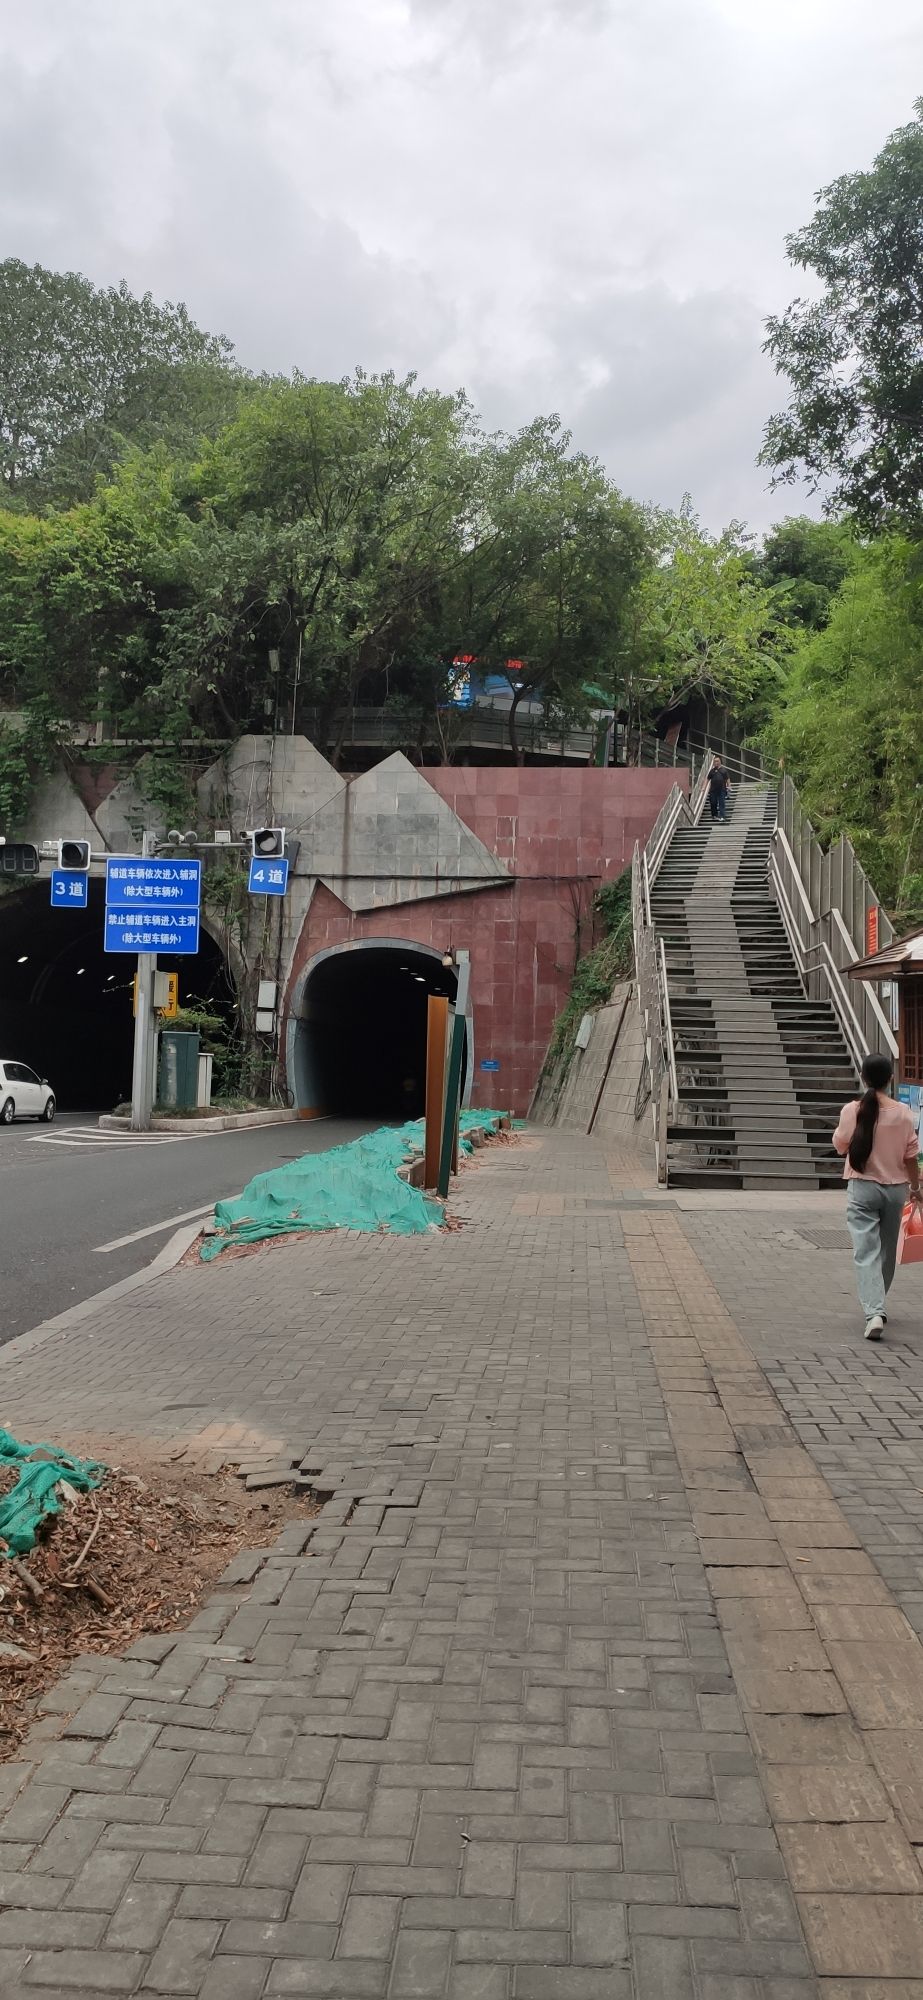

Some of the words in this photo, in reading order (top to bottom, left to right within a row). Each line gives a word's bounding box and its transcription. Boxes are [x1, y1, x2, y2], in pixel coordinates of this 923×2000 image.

[110, 868, 198, 881] 辅道车辆依次进入辅洞
[123, 885, 184, 898] (除大型车辆外)
[108, 914, 196, 926] 禁止辅道车辆进入主洞
[122, 932, 182, 945] (除大型车辆外)
